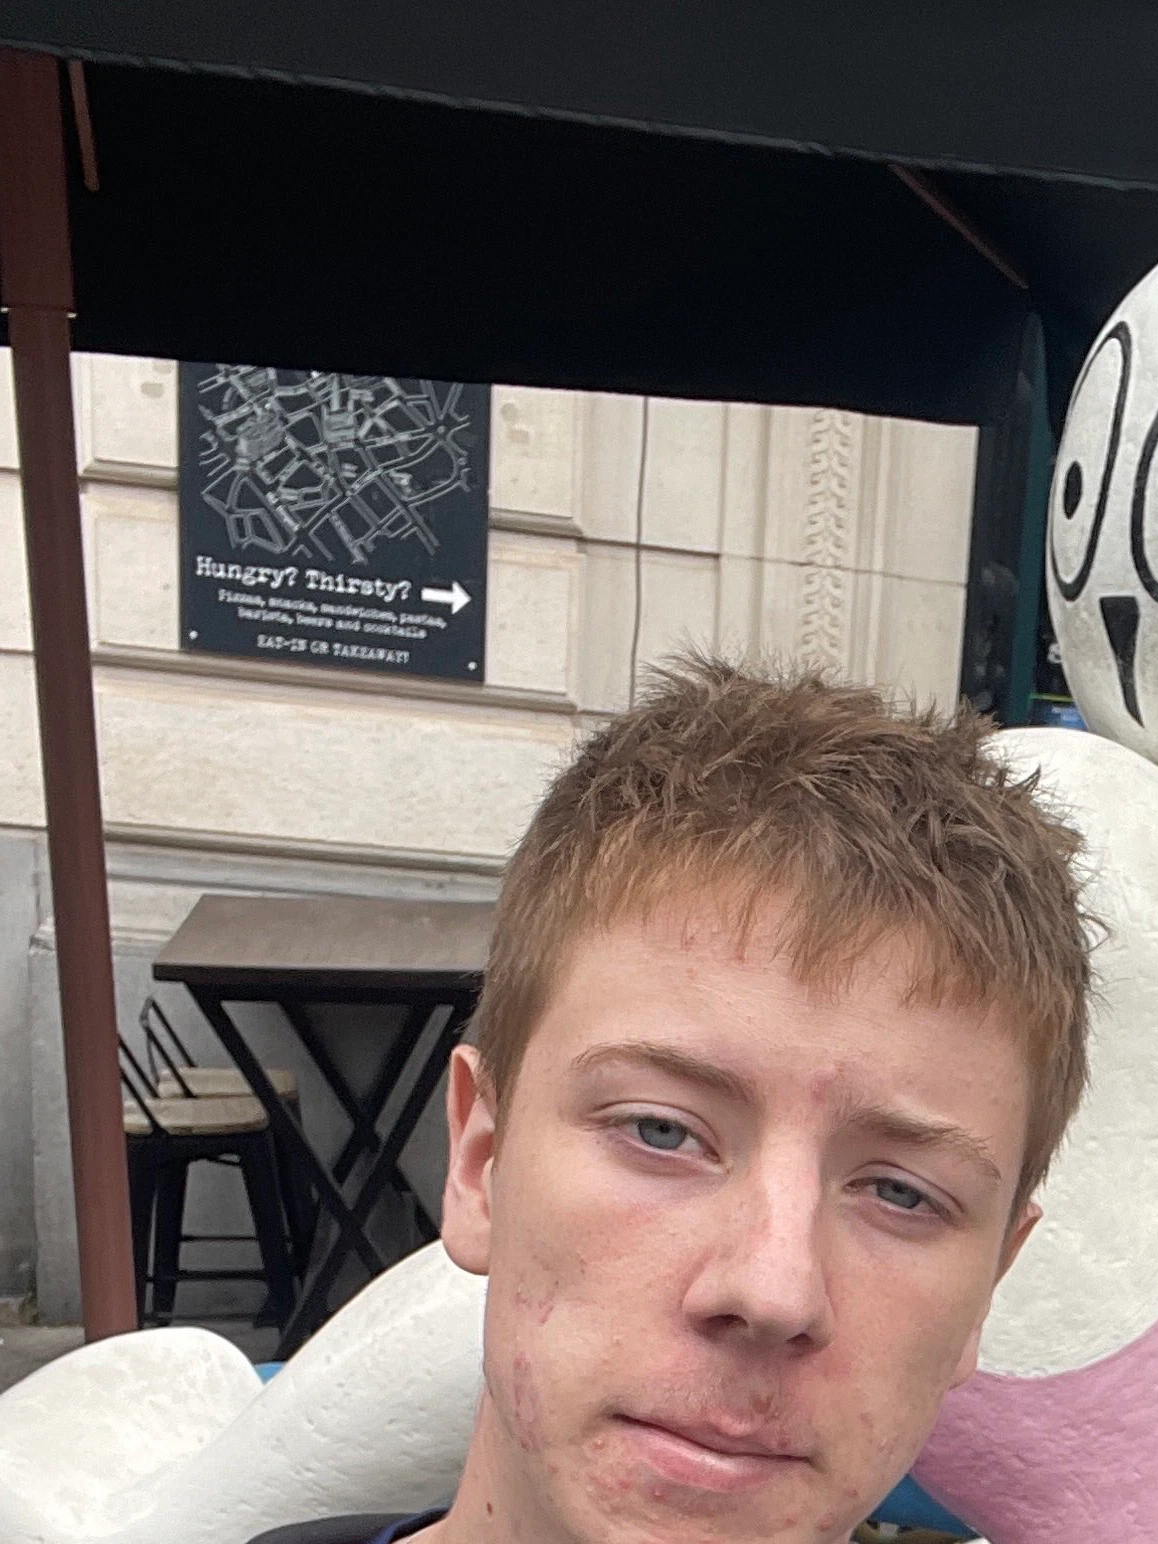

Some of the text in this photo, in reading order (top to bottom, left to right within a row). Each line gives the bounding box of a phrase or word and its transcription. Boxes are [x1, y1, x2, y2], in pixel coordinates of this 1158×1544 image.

[195, 555, 412, 602] Hungry? Thirsty?
[335, 619, 361, 632] and
[311, 640, 330, 655] OR
